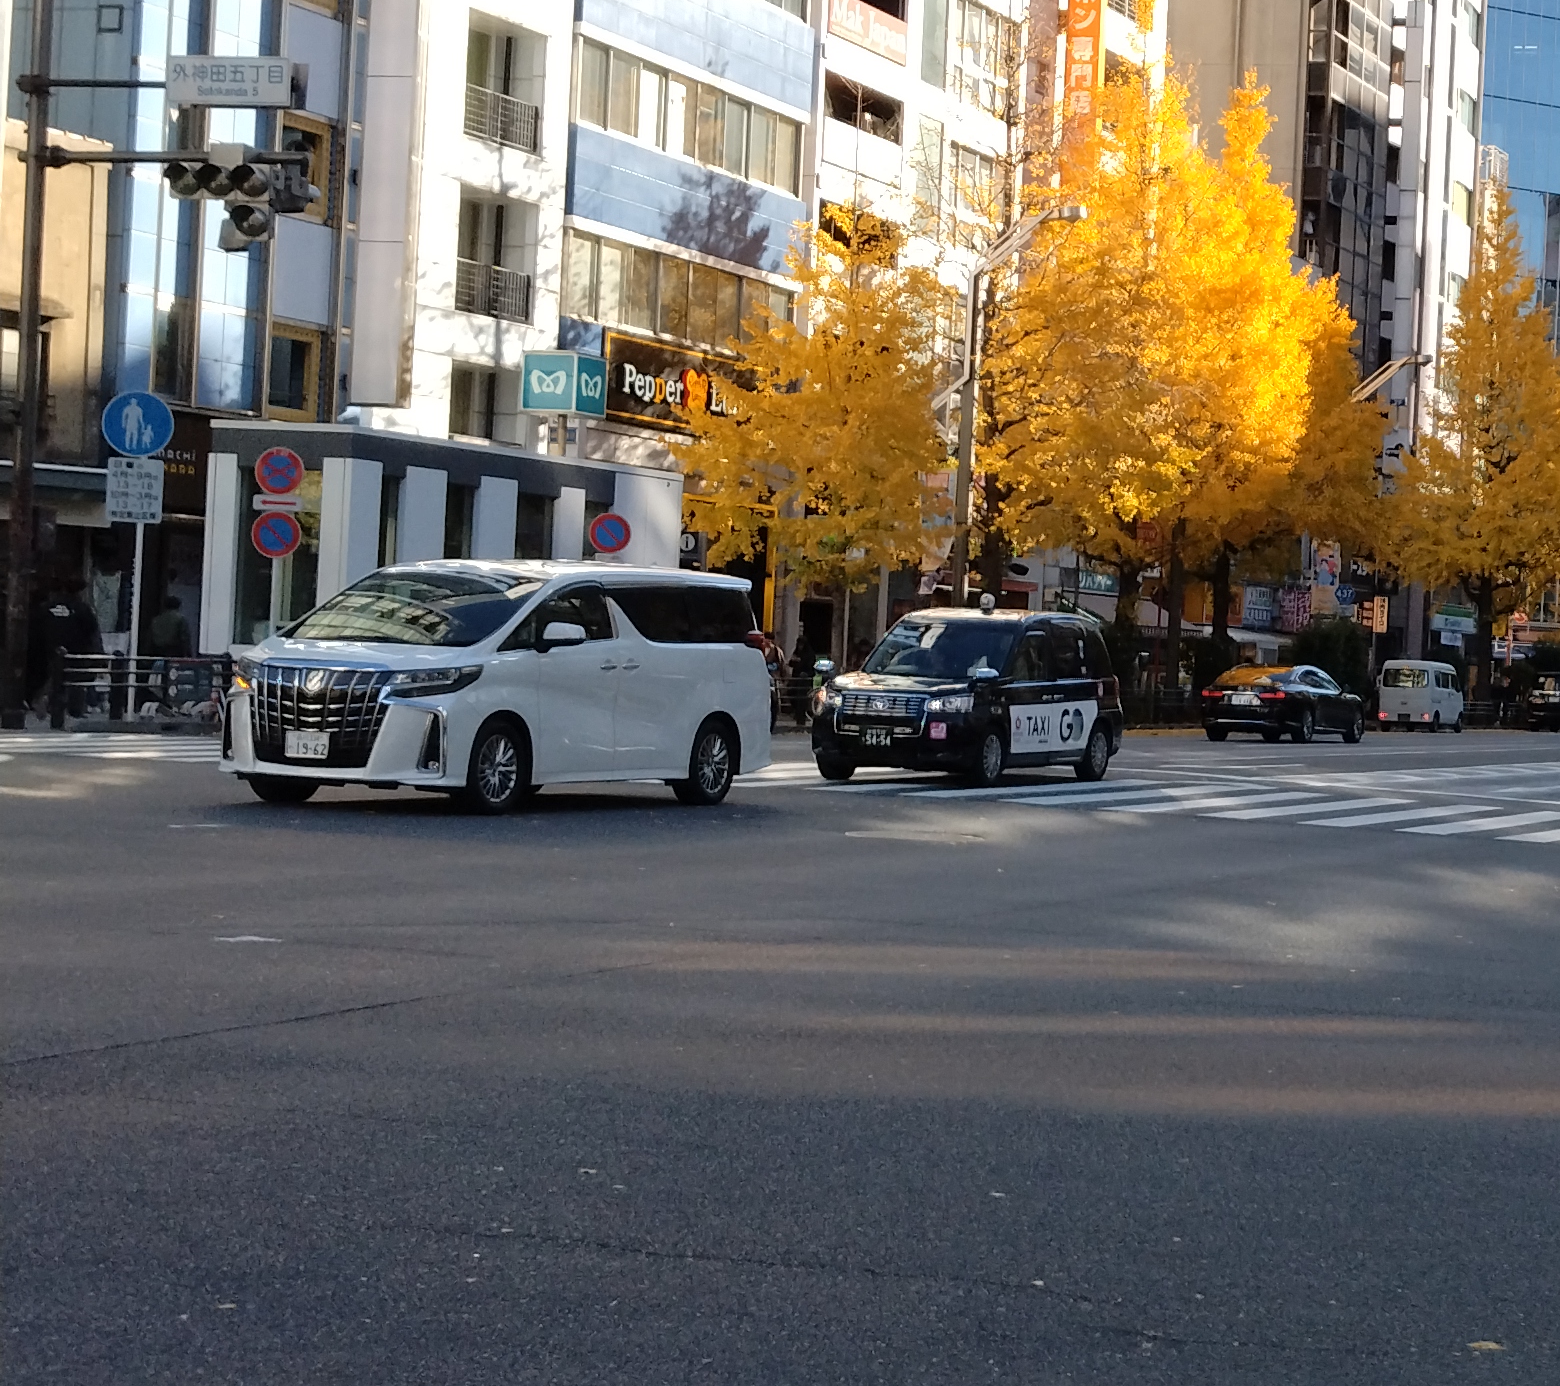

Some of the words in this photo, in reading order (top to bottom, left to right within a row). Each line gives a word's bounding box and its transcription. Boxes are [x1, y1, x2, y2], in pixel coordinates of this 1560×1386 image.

[173, 64, 283, 84] 外神田五丁目
[252, 86, 258, 96] 5
[622, 363, 684, 404] Pepper
[1336, 589, 1353, 599] 437
[1026, 716, 1050, 736] TAXI
[1060, 708, 1084, 744] GO
[296, 742, 326, 755] 19-62
